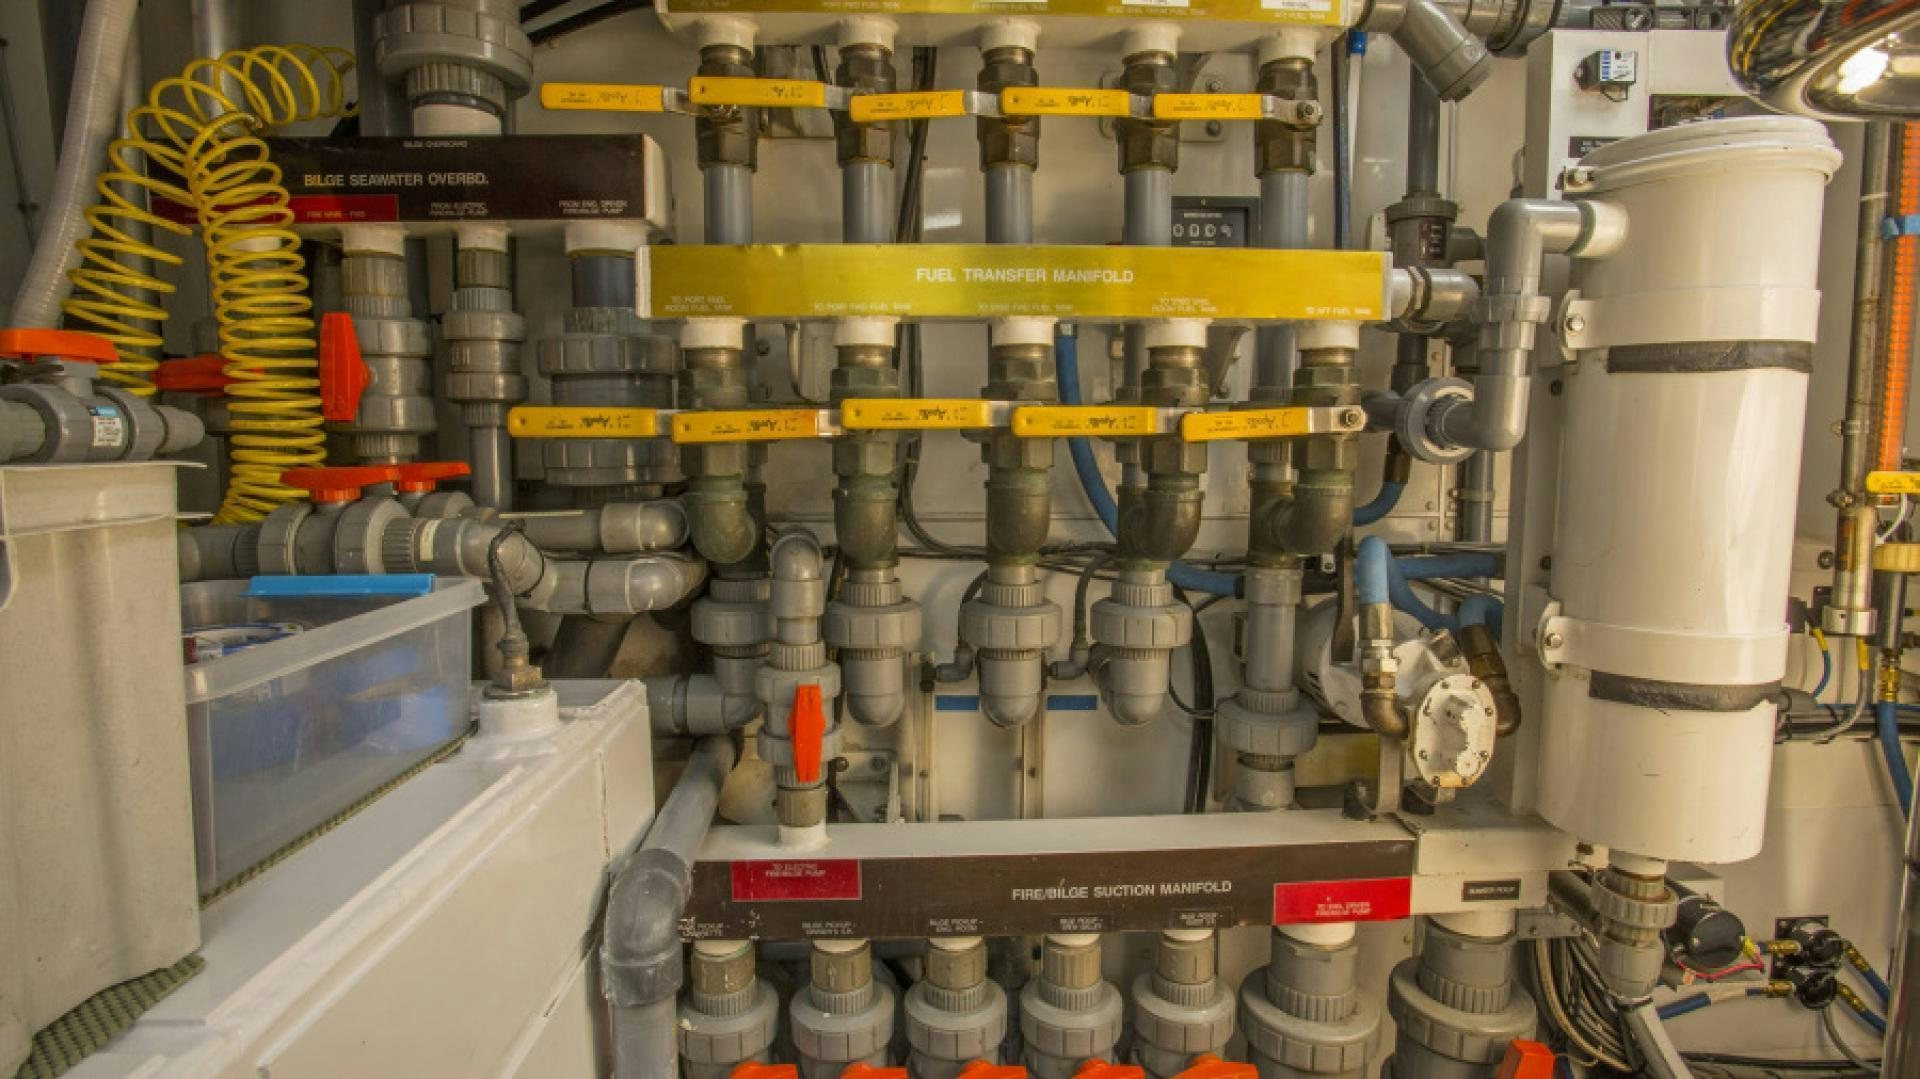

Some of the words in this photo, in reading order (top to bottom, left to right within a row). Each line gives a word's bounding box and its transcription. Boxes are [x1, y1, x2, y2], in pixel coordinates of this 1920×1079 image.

[304, 174, 345, 187] BILGE
[350, 174, 423, 187] SEAWATER
[428, 172, 489, 186] OVERBD.
[915, 268, 956, 283] FUEL
[963, 268, 1046, 283] TRANSFER
[1053, 269, 1135, 283] MANIFOLD
[1012, 885, 1089, 901] FIRE/BILGE
[1093, 884, 1155, 899] SUCTION
[1160, 880, 1232, 896] MANIFOLD
